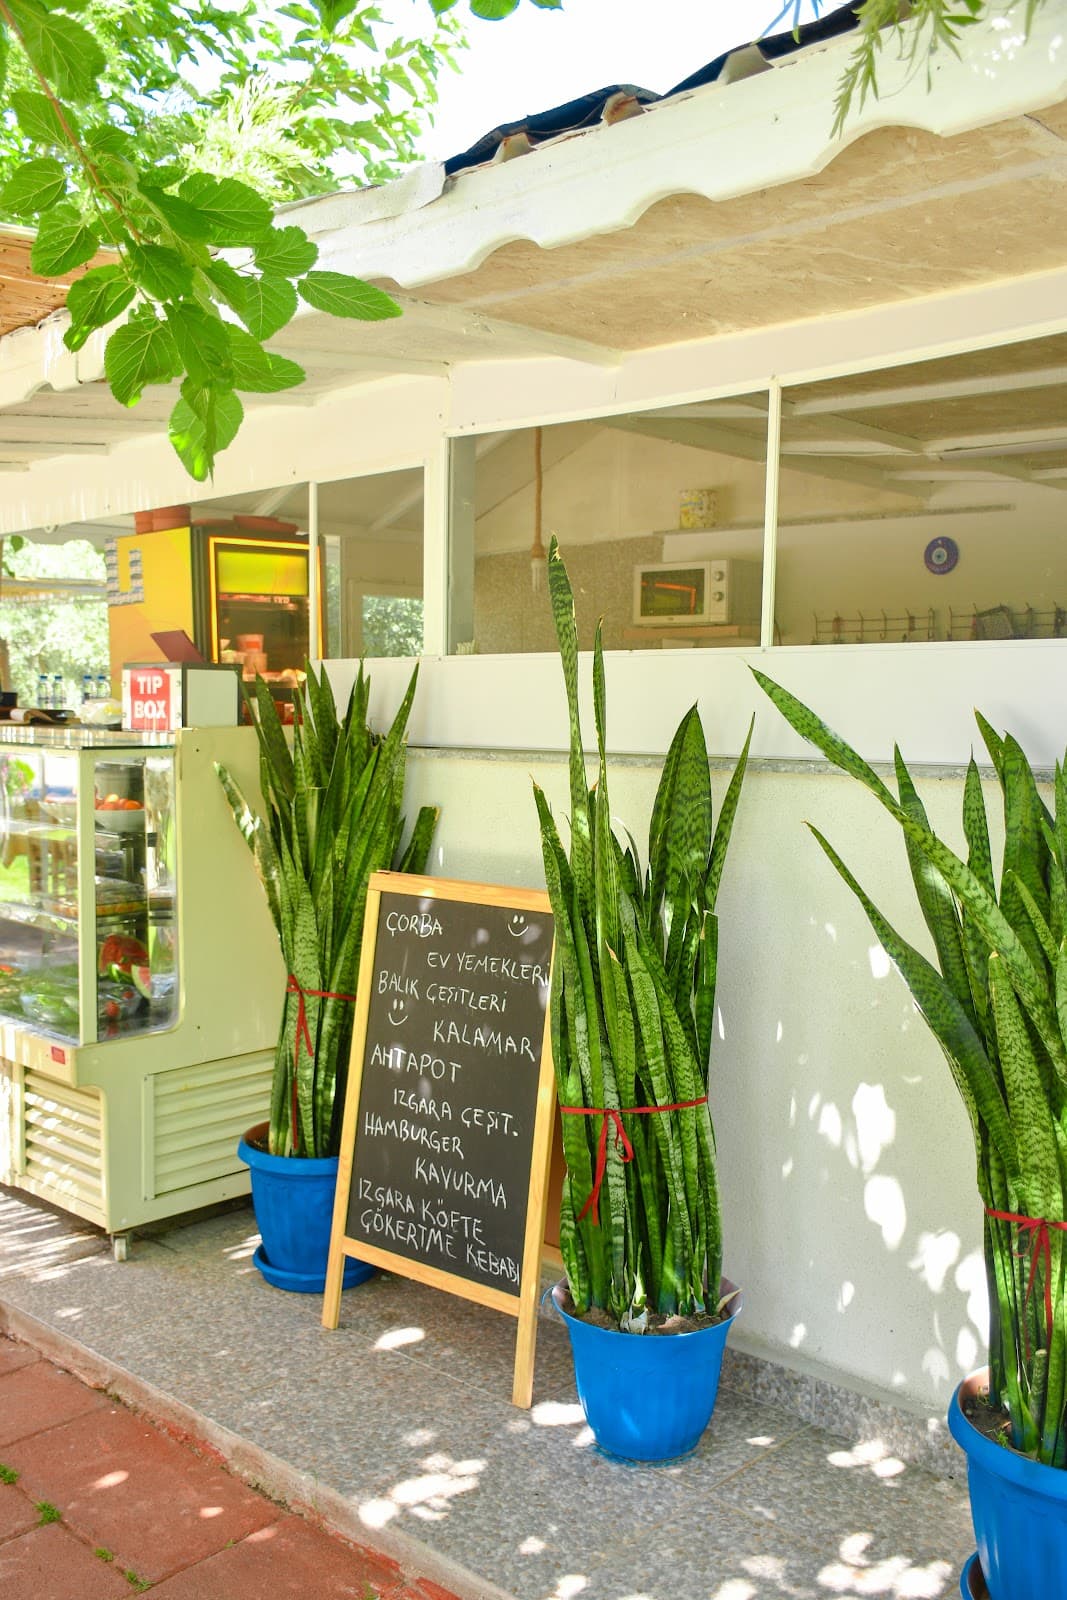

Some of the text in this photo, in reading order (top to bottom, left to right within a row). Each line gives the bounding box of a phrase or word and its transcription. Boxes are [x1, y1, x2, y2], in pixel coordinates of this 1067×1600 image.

[137, 675, 163, 695] TIP
[134, 700, 167, 719] BOX
[386, 912, 443, 938] ÇORBA
[378, 970, 419, 1000] BALIK
[427, 952, 549, 988] EV YEMEKLERİ
[433, 1020, 536, 1062] KALAMAR
[370, 1043, 462, 1083] AHTAPOT
[393, 1088, 452, 1121] IZGARA
[364, 1112, 464, 1160] HAMBURGER
[415, 1156, 507, 1210] KAVURMA
[359, 1177, 486, 1246] IZGARA KÖFTE
[466, 1243, 520, 1287] KEBABI
